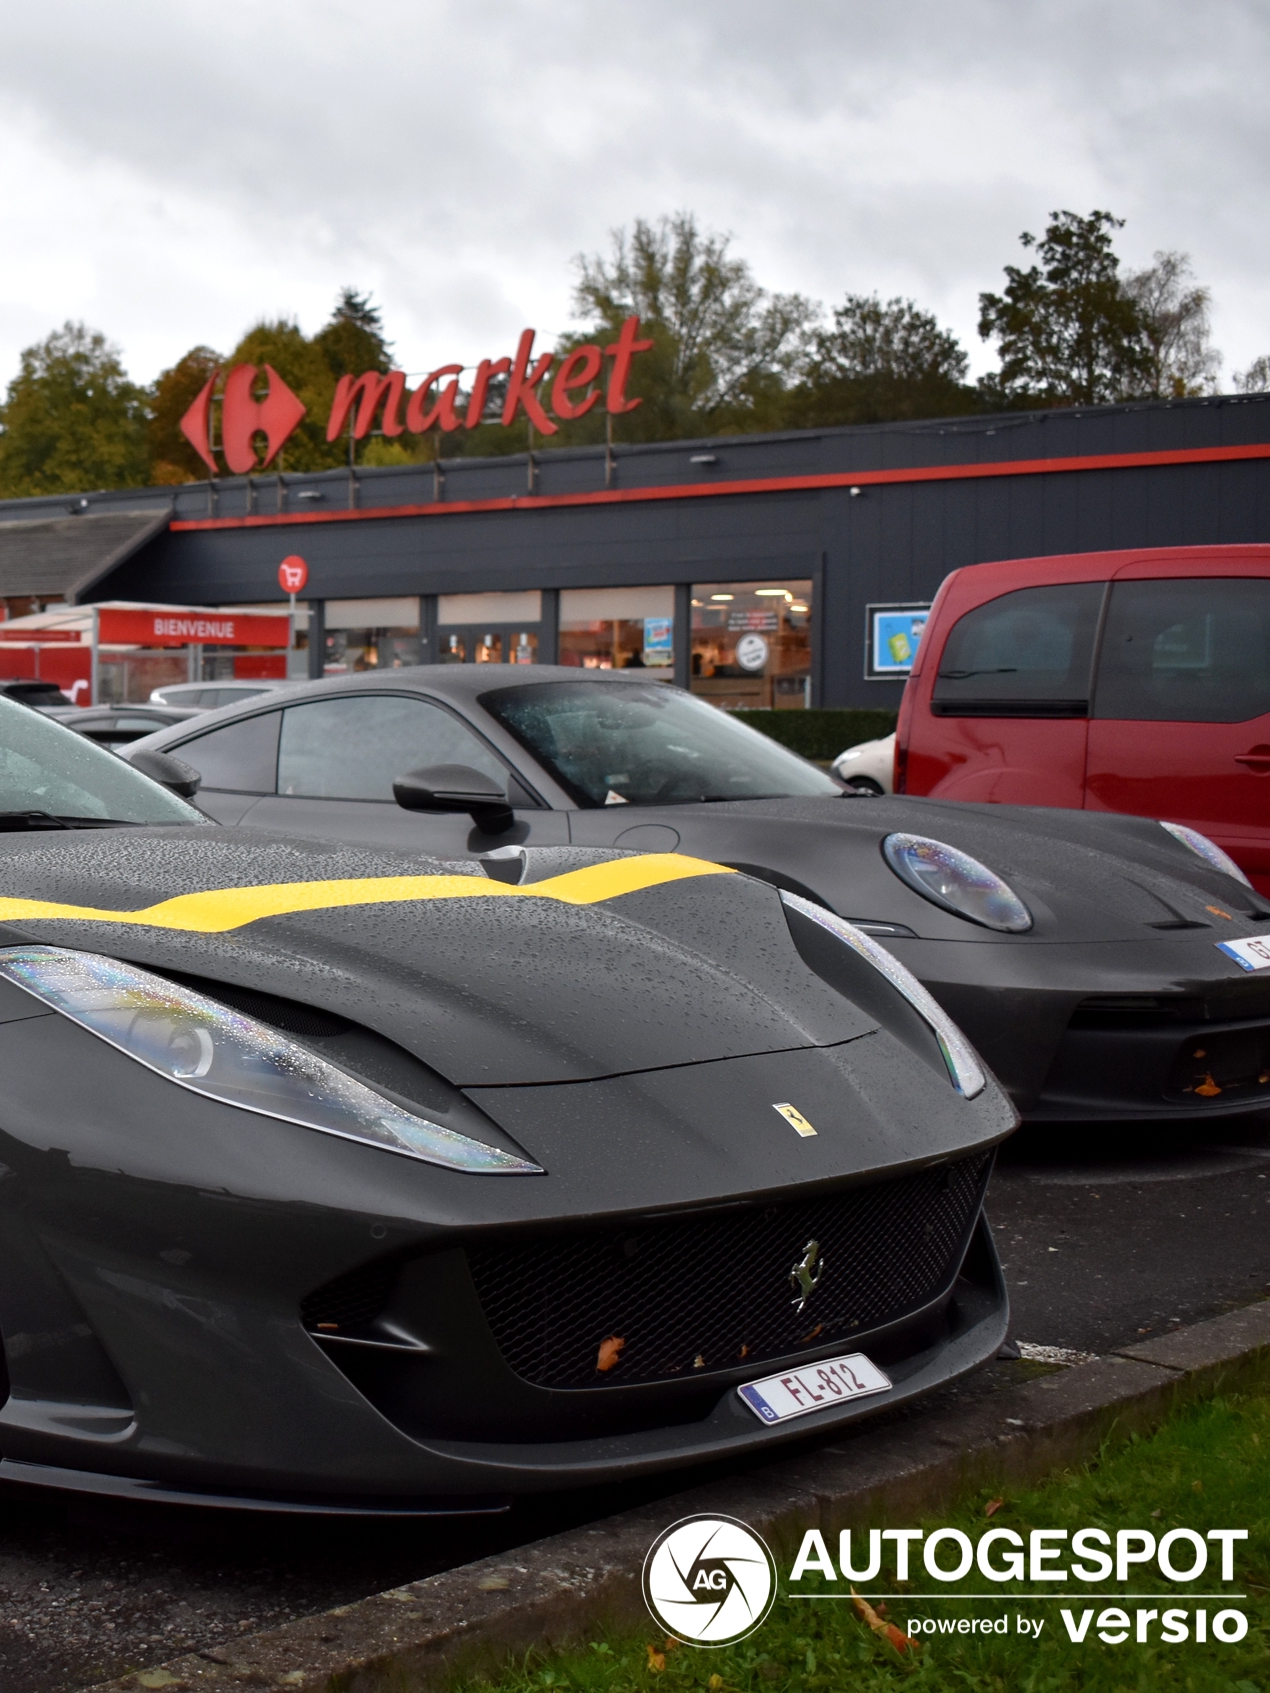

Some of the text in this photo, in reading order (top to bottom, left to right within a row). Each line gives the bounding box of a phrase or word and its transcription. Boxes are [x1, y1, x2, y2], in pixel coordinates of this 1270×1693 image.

[326, 314, 654, 442] market
[153, 618, 235, 638] BIENVENUE
[780, 1363, 866, 1406] FL-812
[760, 1406, 775, 1419] B
